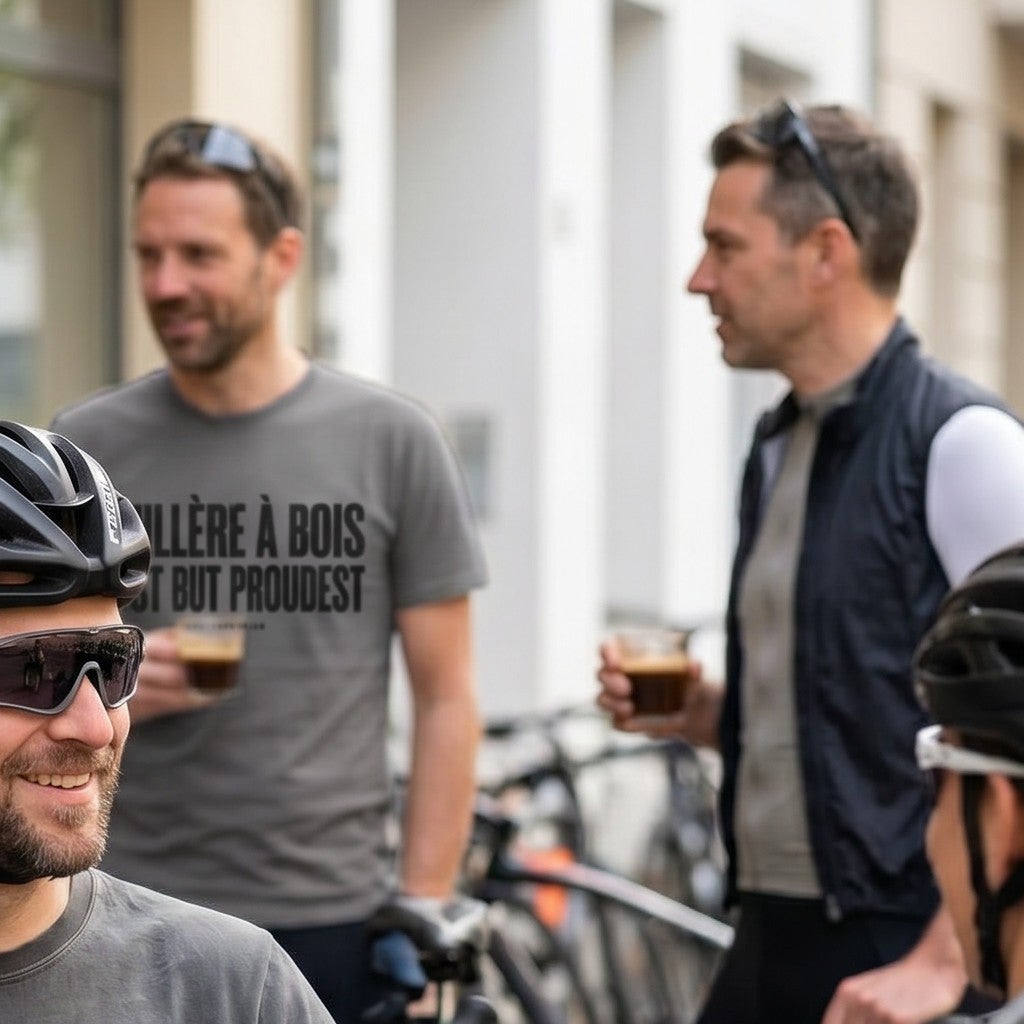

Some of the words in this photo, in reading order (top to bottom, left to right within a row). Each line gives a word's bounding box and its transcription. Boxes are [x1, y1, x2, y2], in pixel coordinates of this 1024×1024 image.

[134, 494, 246, 559] ILLÈRE
[255, 494, 279, 559] À
[288, 503, 366, 559] BOIS
[171, 564, 222, 613] BUT
[229, 564, 366, 613] PROUDEST
